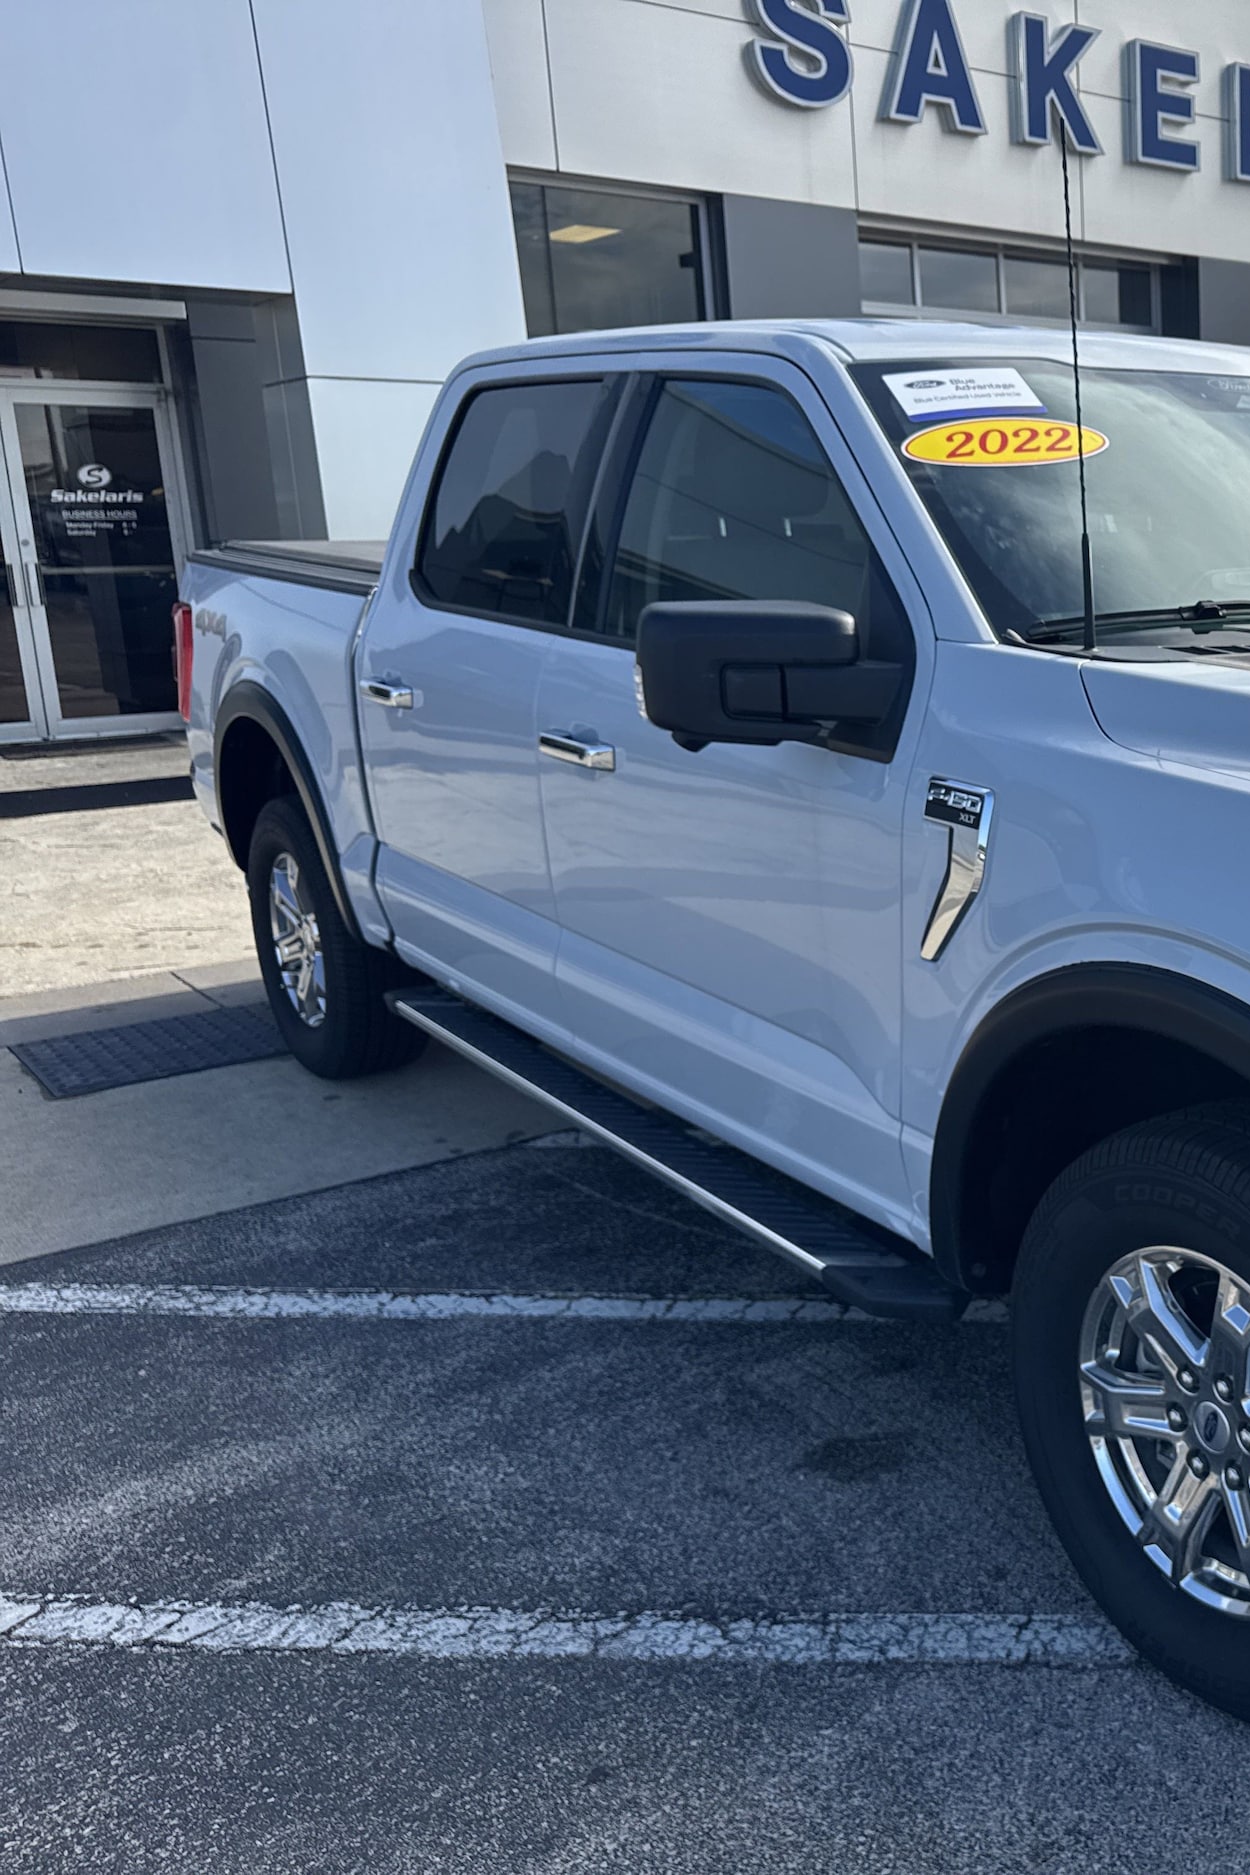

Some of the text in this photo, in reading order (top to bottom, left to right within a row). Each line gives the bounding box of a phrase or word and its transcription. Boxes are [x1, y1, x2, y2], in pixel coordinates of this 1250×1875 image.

[955, 383, 1015, 392] Advantage
[945, 427, 1073, 459] 2022
[51, 488, 143, 503] Sakelaris
[959, 812, 976, 824] XLT
[1114, 1183, 1240, 1241] COOPER
